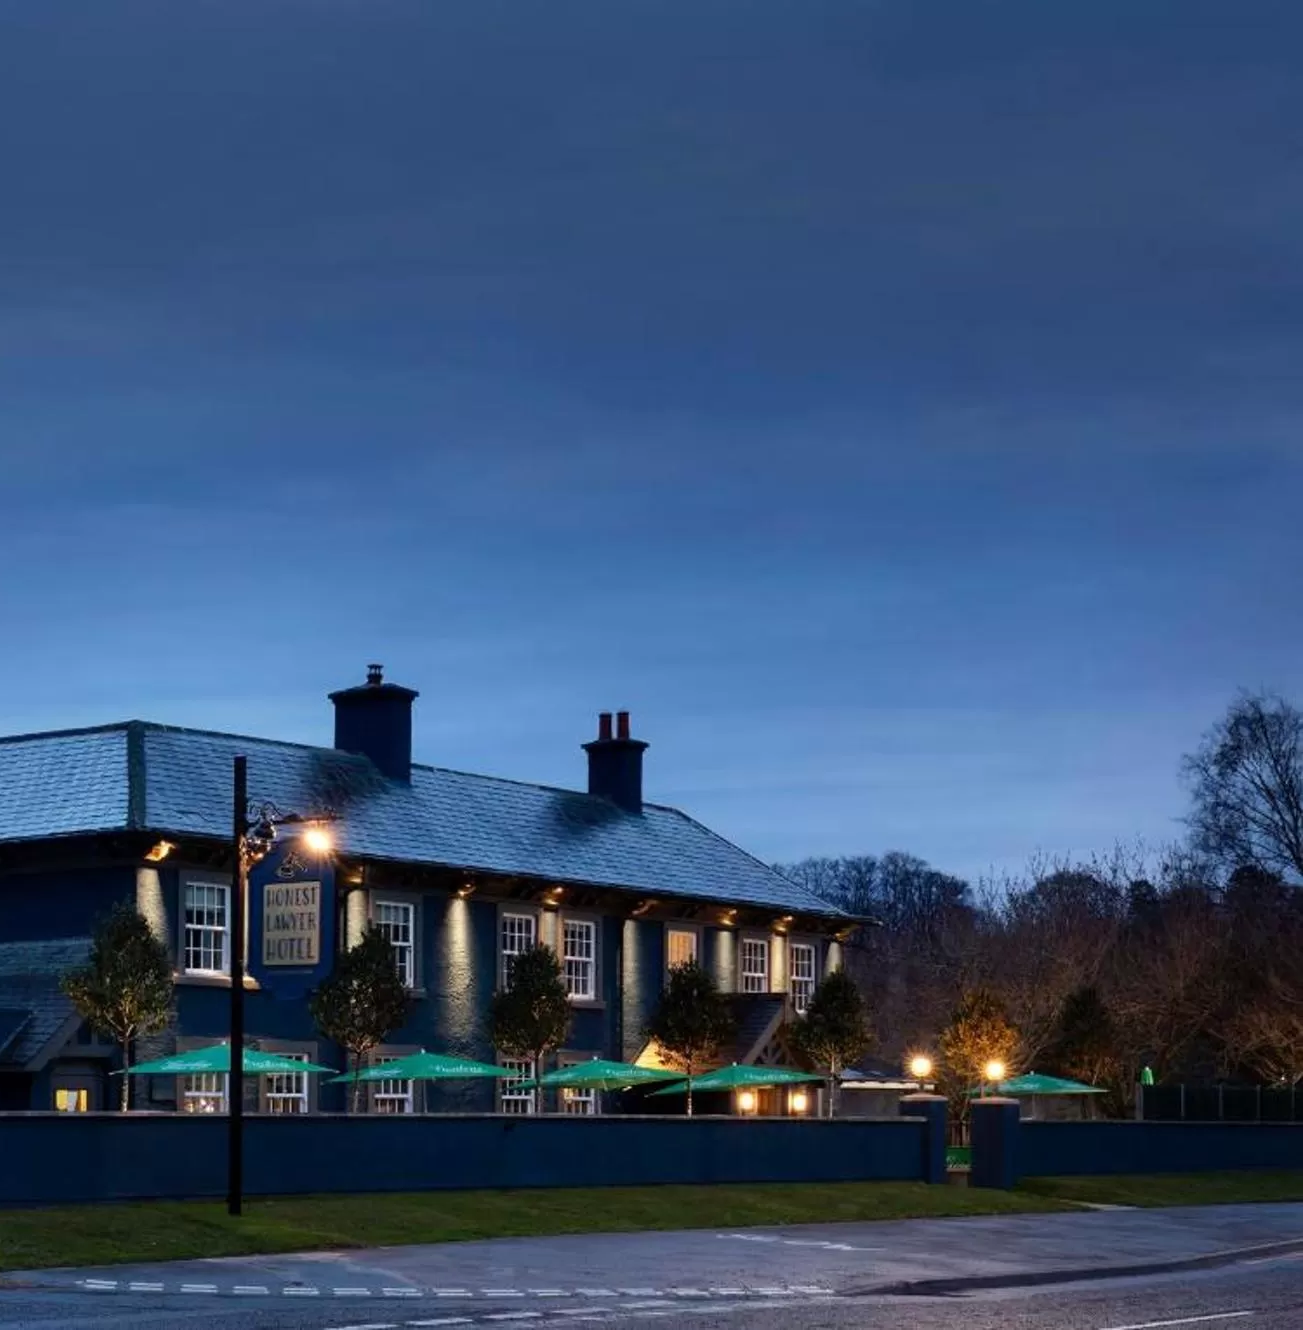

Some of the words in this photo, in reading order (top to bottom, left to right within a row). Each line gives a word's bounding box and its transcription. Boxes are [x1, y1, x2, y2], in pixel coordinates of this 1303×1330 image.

[266, 887, 318, 907] HONEST
[266, 911, 317, 932] LAWYER
[266, 937, 316, 961] HOTEL
